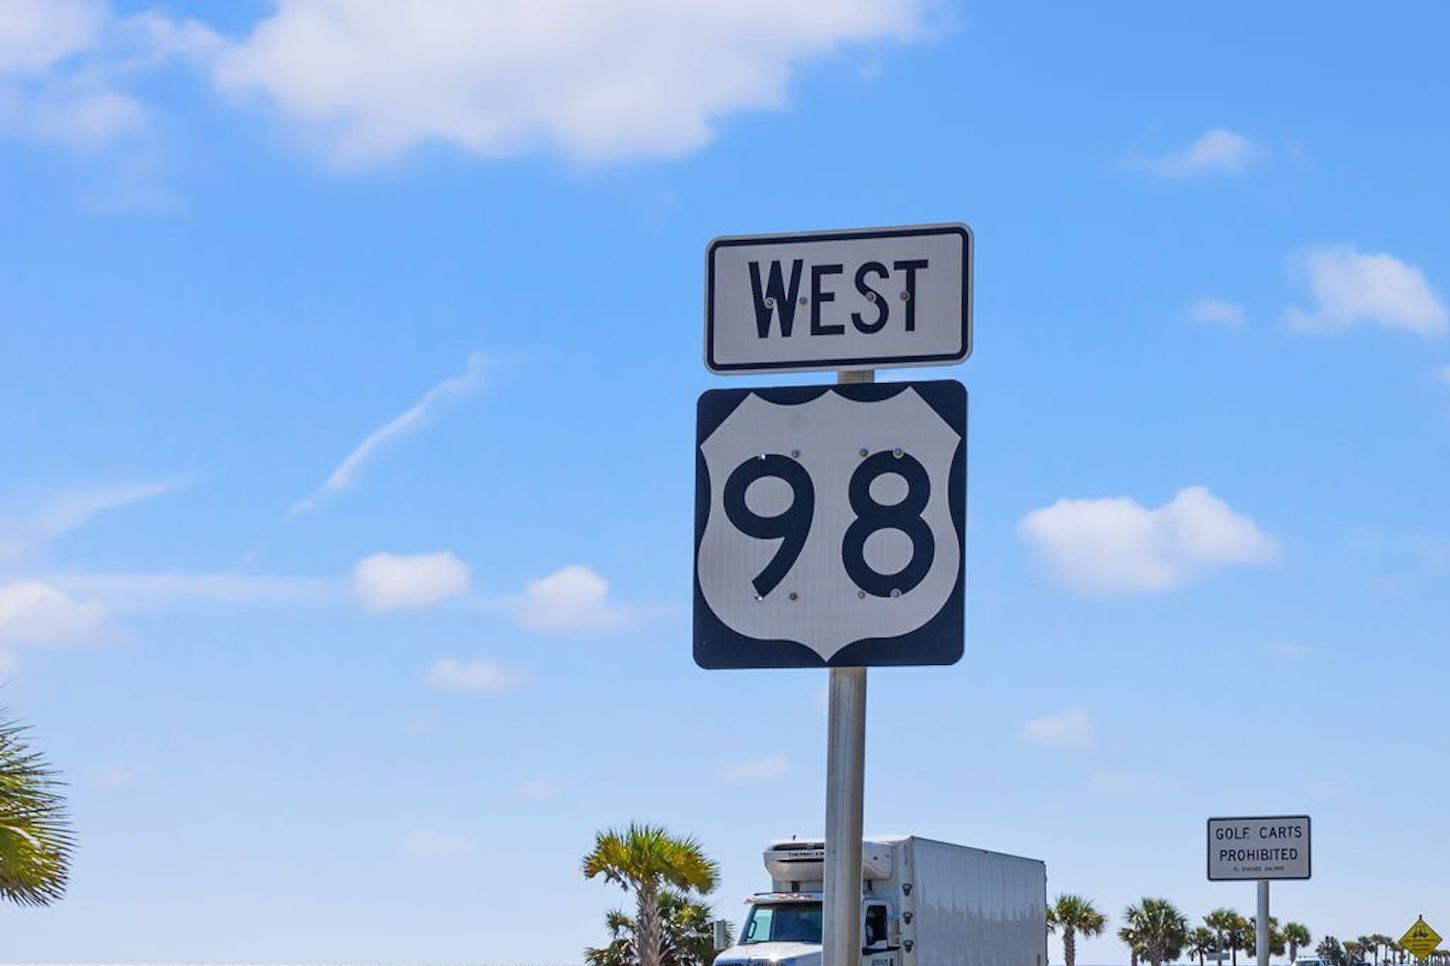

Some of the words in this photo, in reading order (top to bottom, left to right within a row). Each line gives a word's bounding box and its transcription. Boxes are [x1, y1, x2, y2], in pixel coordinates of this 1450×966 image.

[748, 259, 929, 339] WEST
[723, 450, 935, 600] 98
[1215, 827, 1250, 840] GOLF
[1259, 826, 1302, 839] CARTS
[1220, 848, 1298, 861] PROHIBITED
